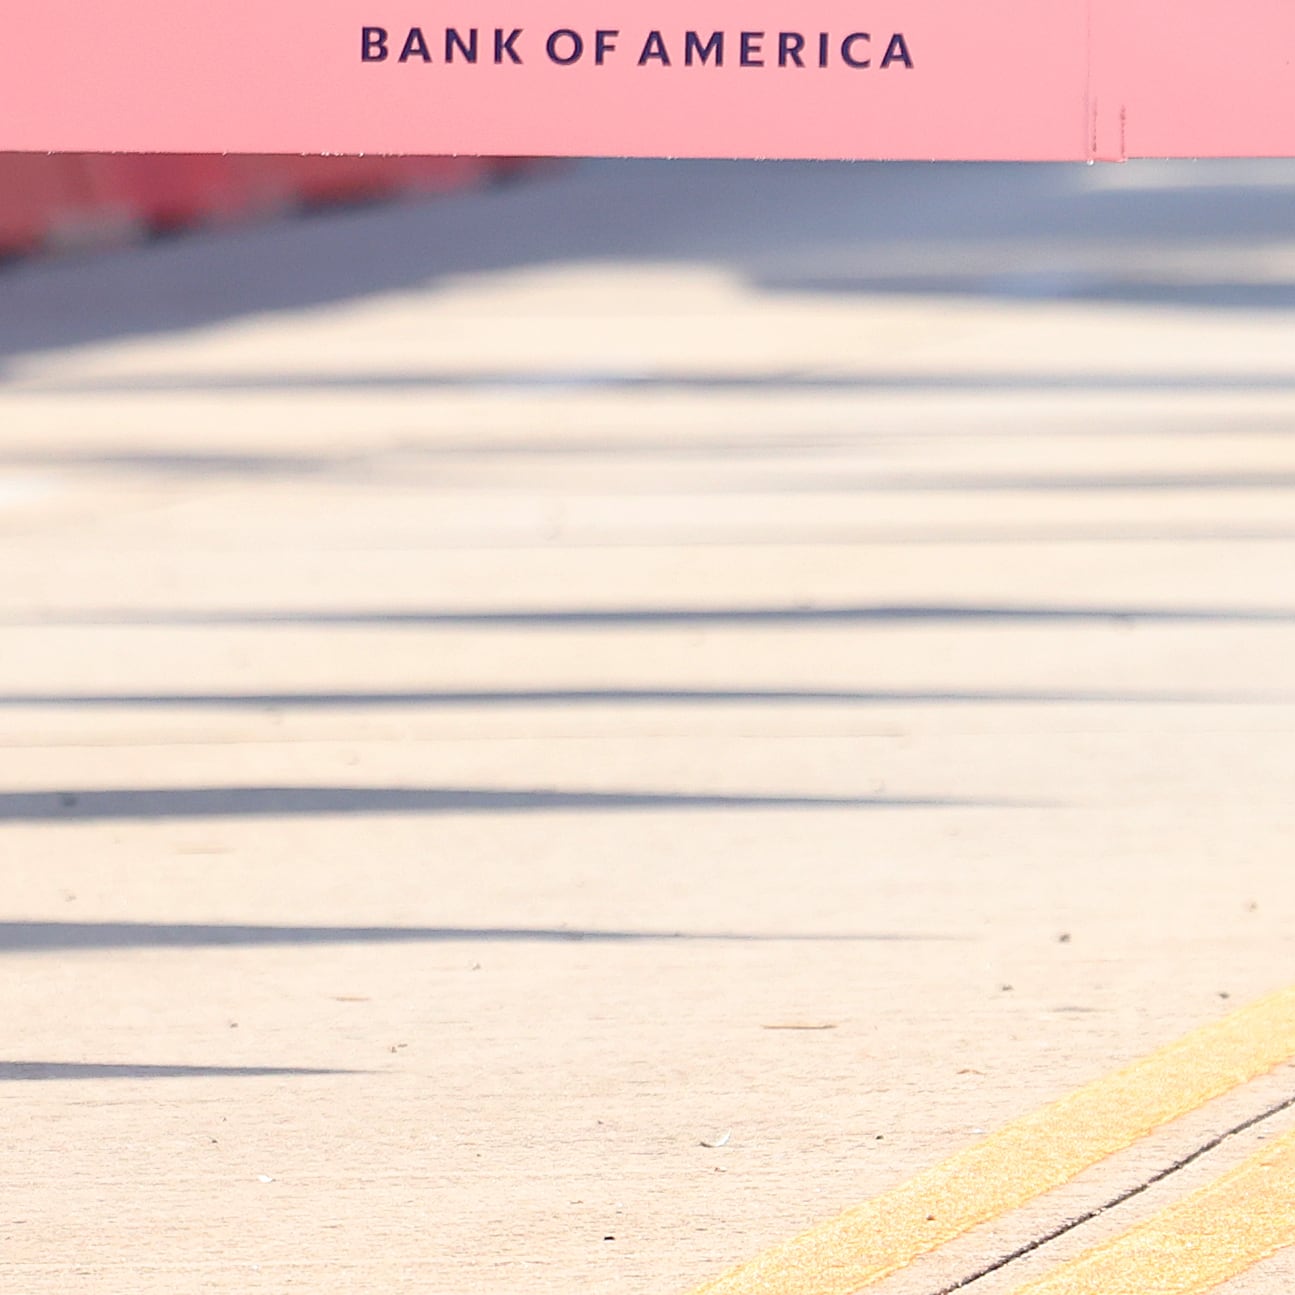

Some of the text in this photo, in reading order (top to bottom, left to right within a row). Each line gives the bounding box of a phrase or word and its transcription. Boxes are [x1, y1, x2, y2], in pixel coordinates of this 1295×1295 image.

[362, 25, 914, 70] BANK OF AMERICA
